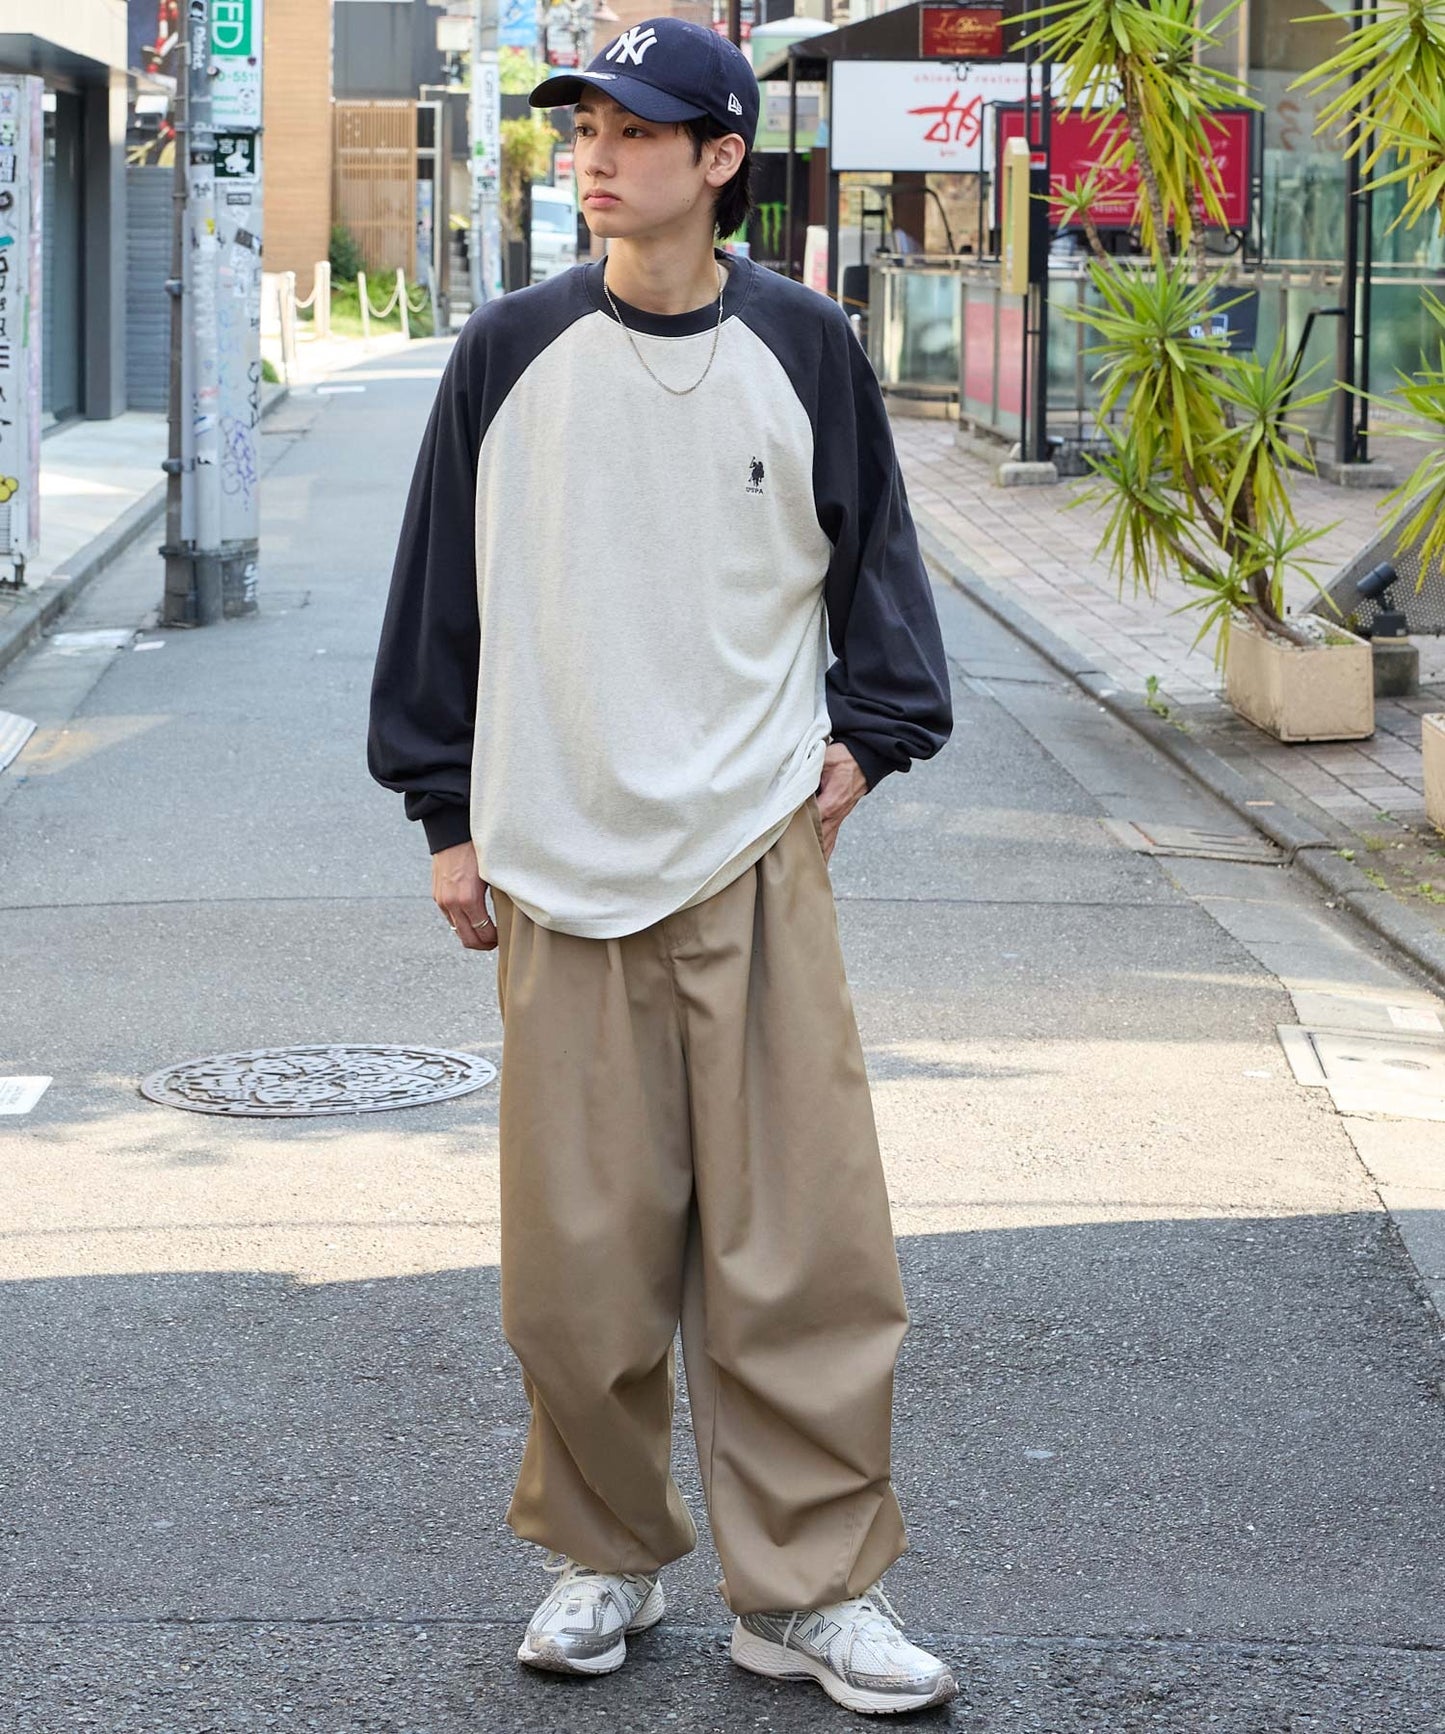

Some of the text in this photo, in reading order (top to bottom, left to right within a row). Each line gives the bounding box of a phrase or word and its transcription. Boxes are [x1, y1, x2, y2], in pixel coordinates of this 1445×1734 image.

[212, 0, 244, 49] ED
[605, 26, 657, 66] NY
[793, 1610, 843, 1651] N
